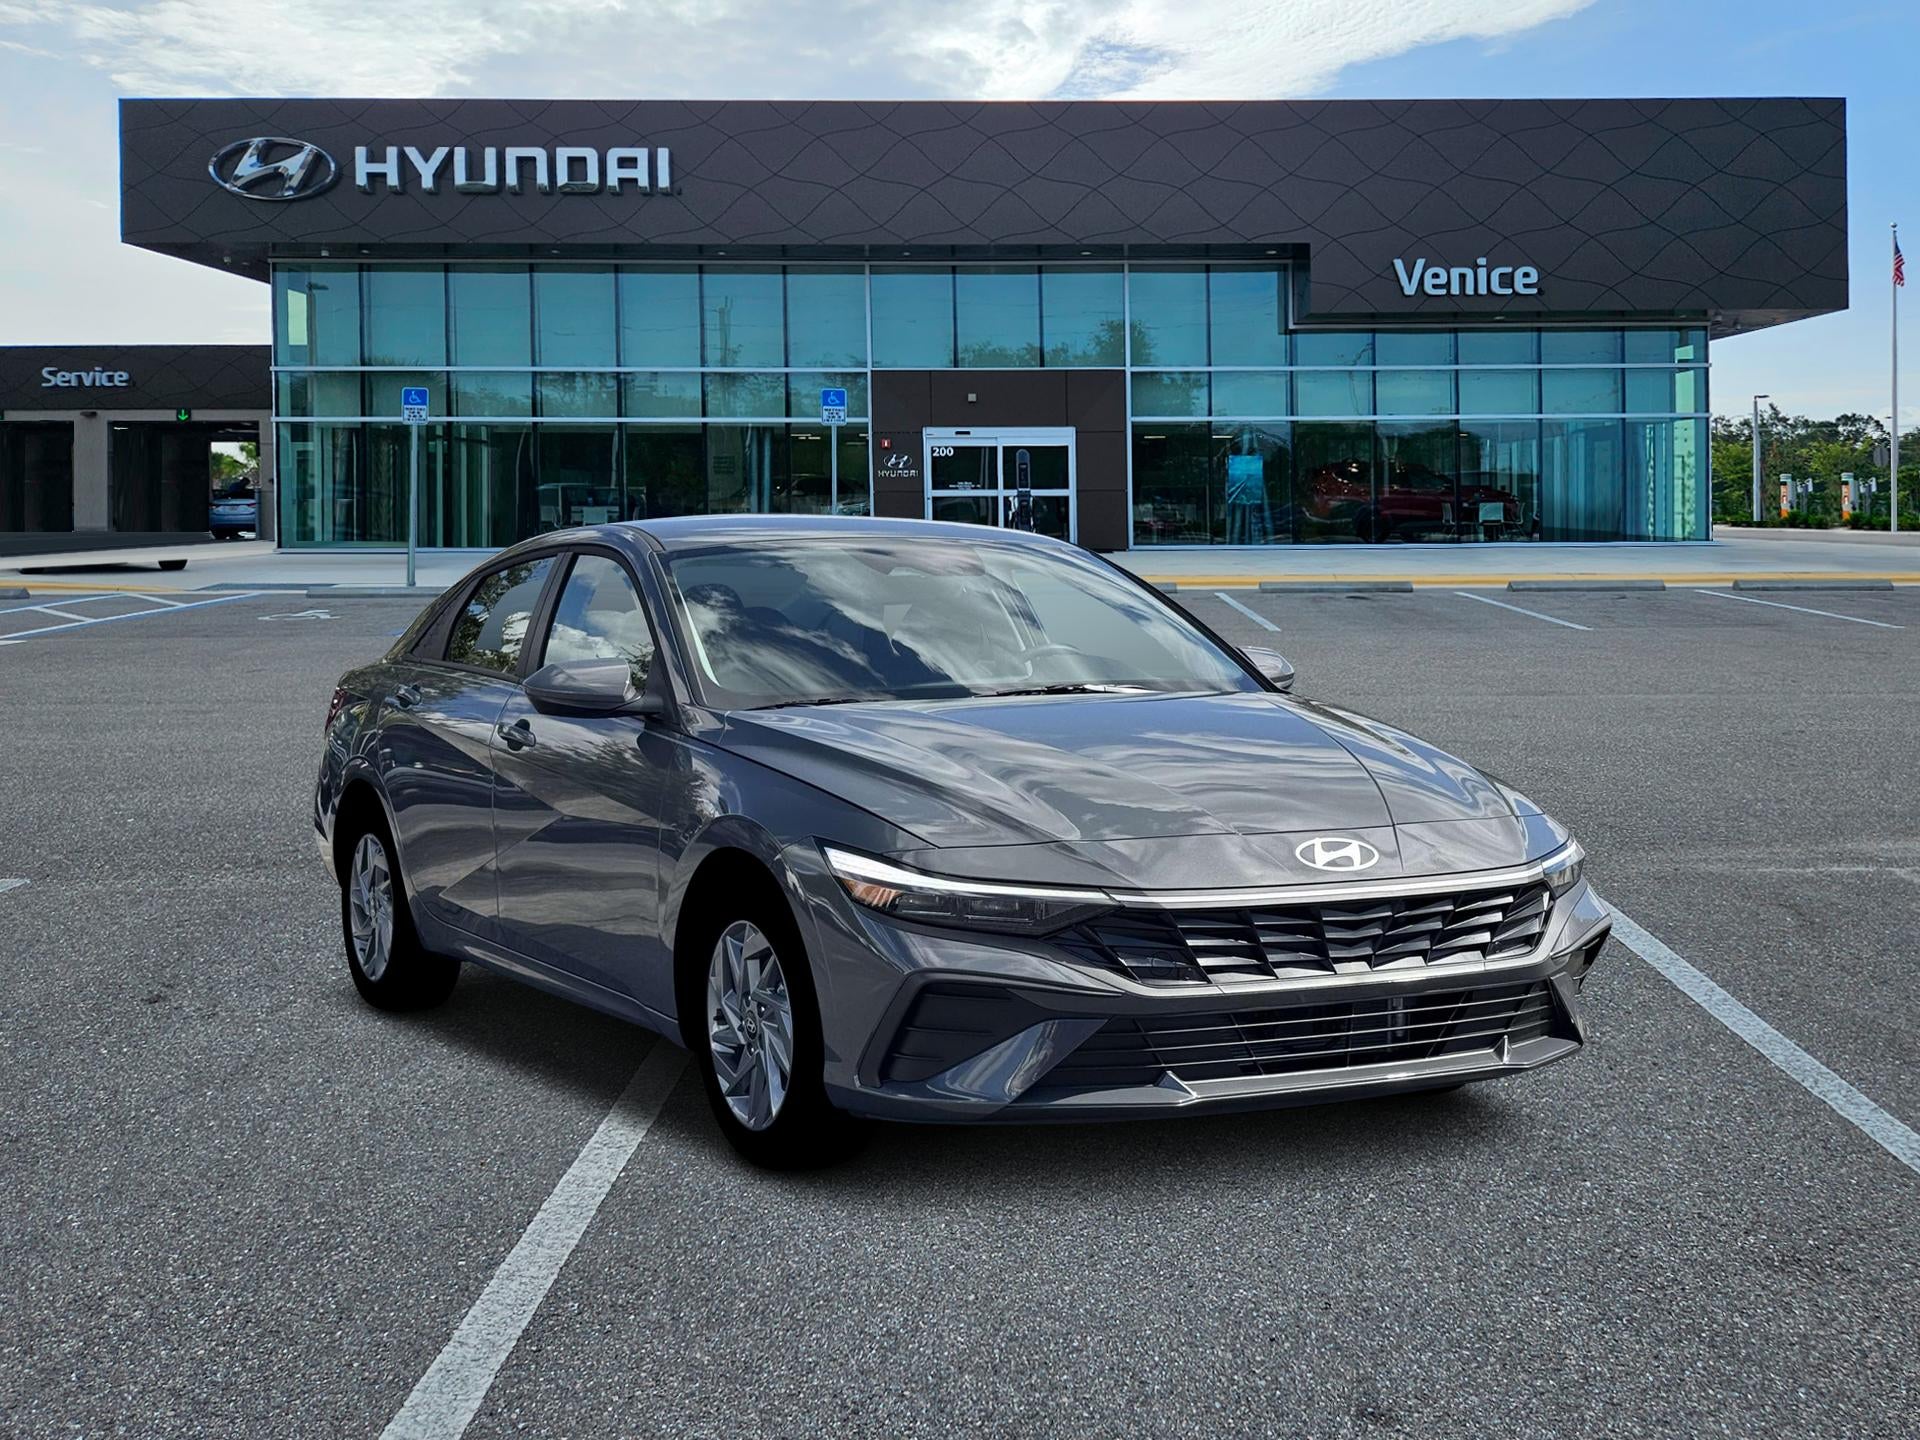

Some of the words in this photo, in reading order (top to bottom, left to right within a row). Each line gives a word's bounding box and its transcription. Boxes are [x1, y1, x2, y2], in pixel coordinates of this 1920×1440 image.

[354, 145, 671, 195] HYUNDAI
[1392, 256, 1539, 296] Venice
[41, 361, 130, 387] Service
[932, 446, 954, 457] 200
[877, 469, 919, 478] HYUNDAI
